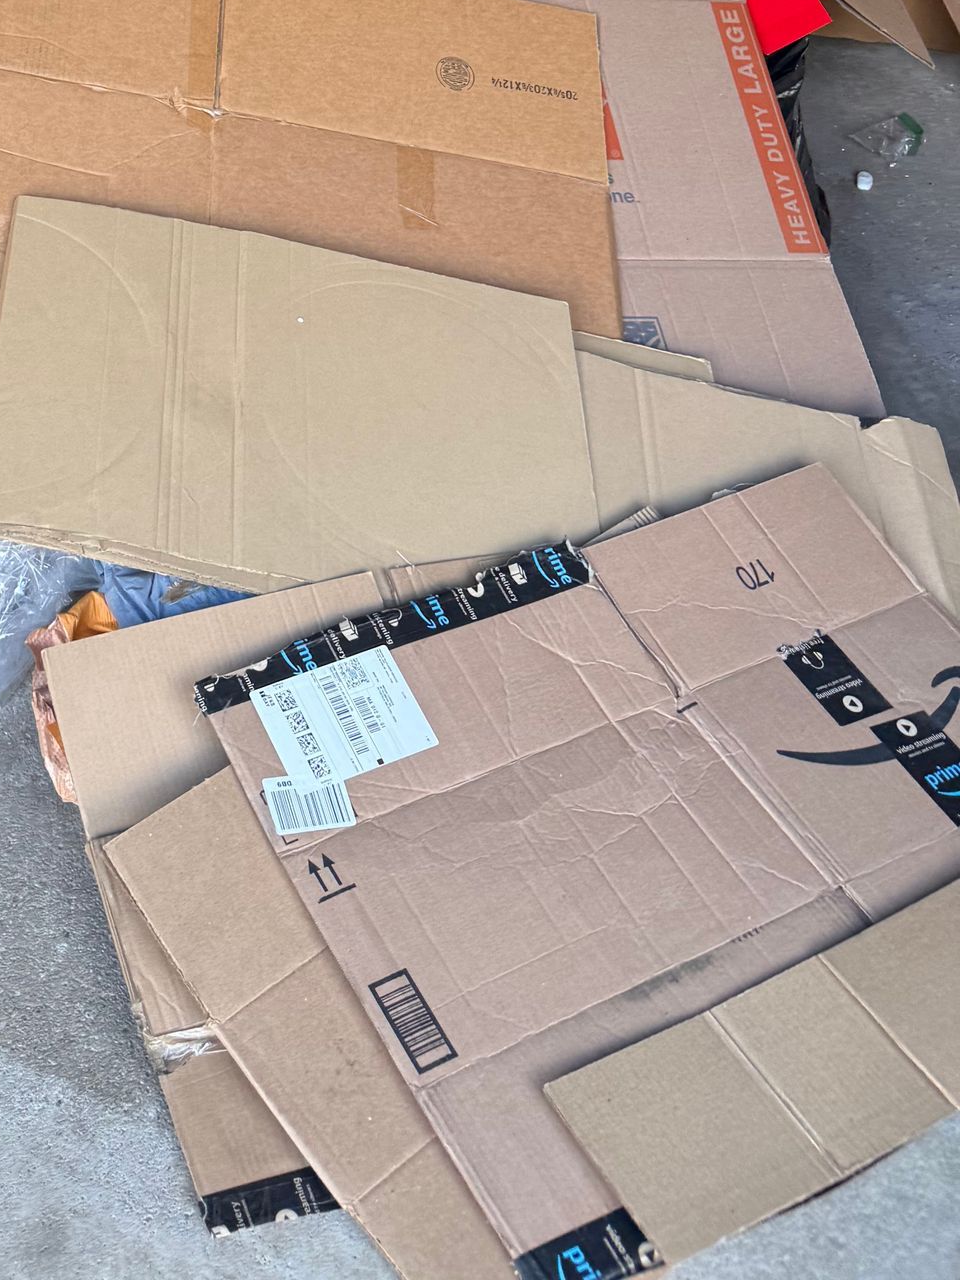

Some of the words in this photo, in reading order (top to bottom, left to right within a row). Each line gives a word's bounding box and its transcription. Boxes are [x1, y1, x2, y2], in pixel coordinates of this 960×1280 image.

[720, 8, 764, 95] LARGE
[752, 105, 785, 163] DUTY
[772, 170, 812, 245] HEAVY
[498, 571, 519, 603] delivery
[735, 559, 776, 591] 170
[815, 682, 847, 700] streaming
[846, 677, 863, 690] video
[896, 741, 915, 755] video
[914, 730, 946, 748] streaming
